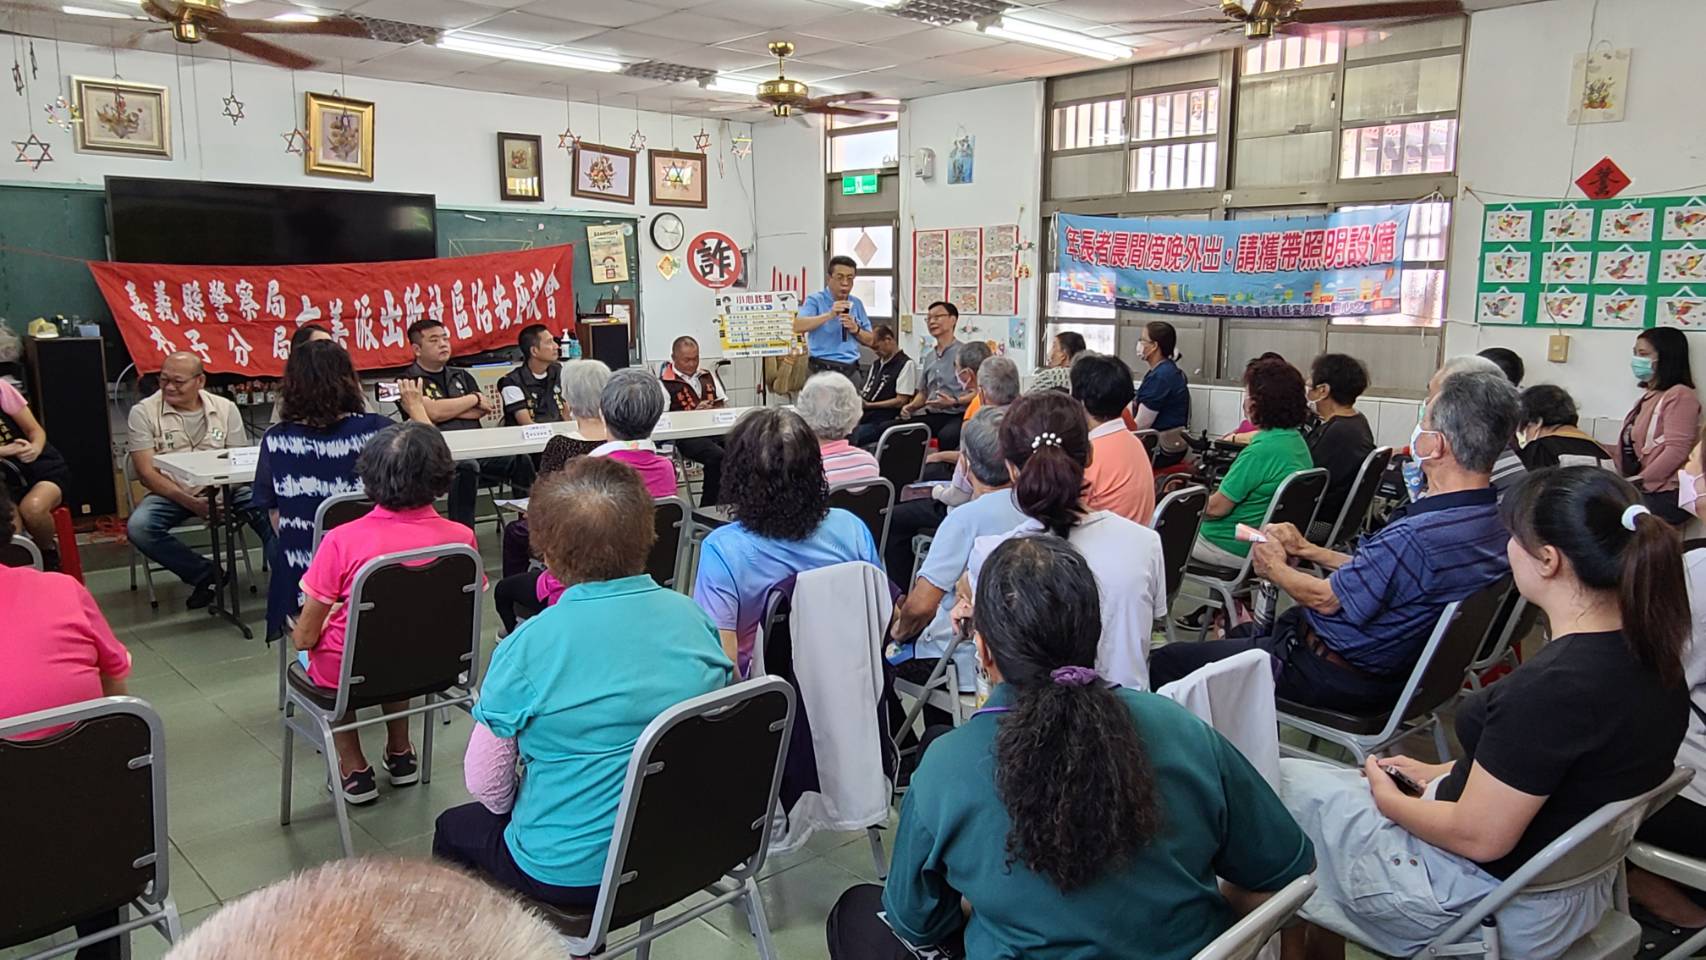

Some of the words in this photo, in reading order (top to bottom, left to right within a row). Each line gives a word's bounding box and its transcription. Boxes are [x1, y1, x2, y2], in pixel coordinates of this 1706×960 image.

[696, 239, 732, 278] 詐
[124, 279, 287, 325] 嘉義縣警察局
[147, 324, 291, 367] 朴子分局
